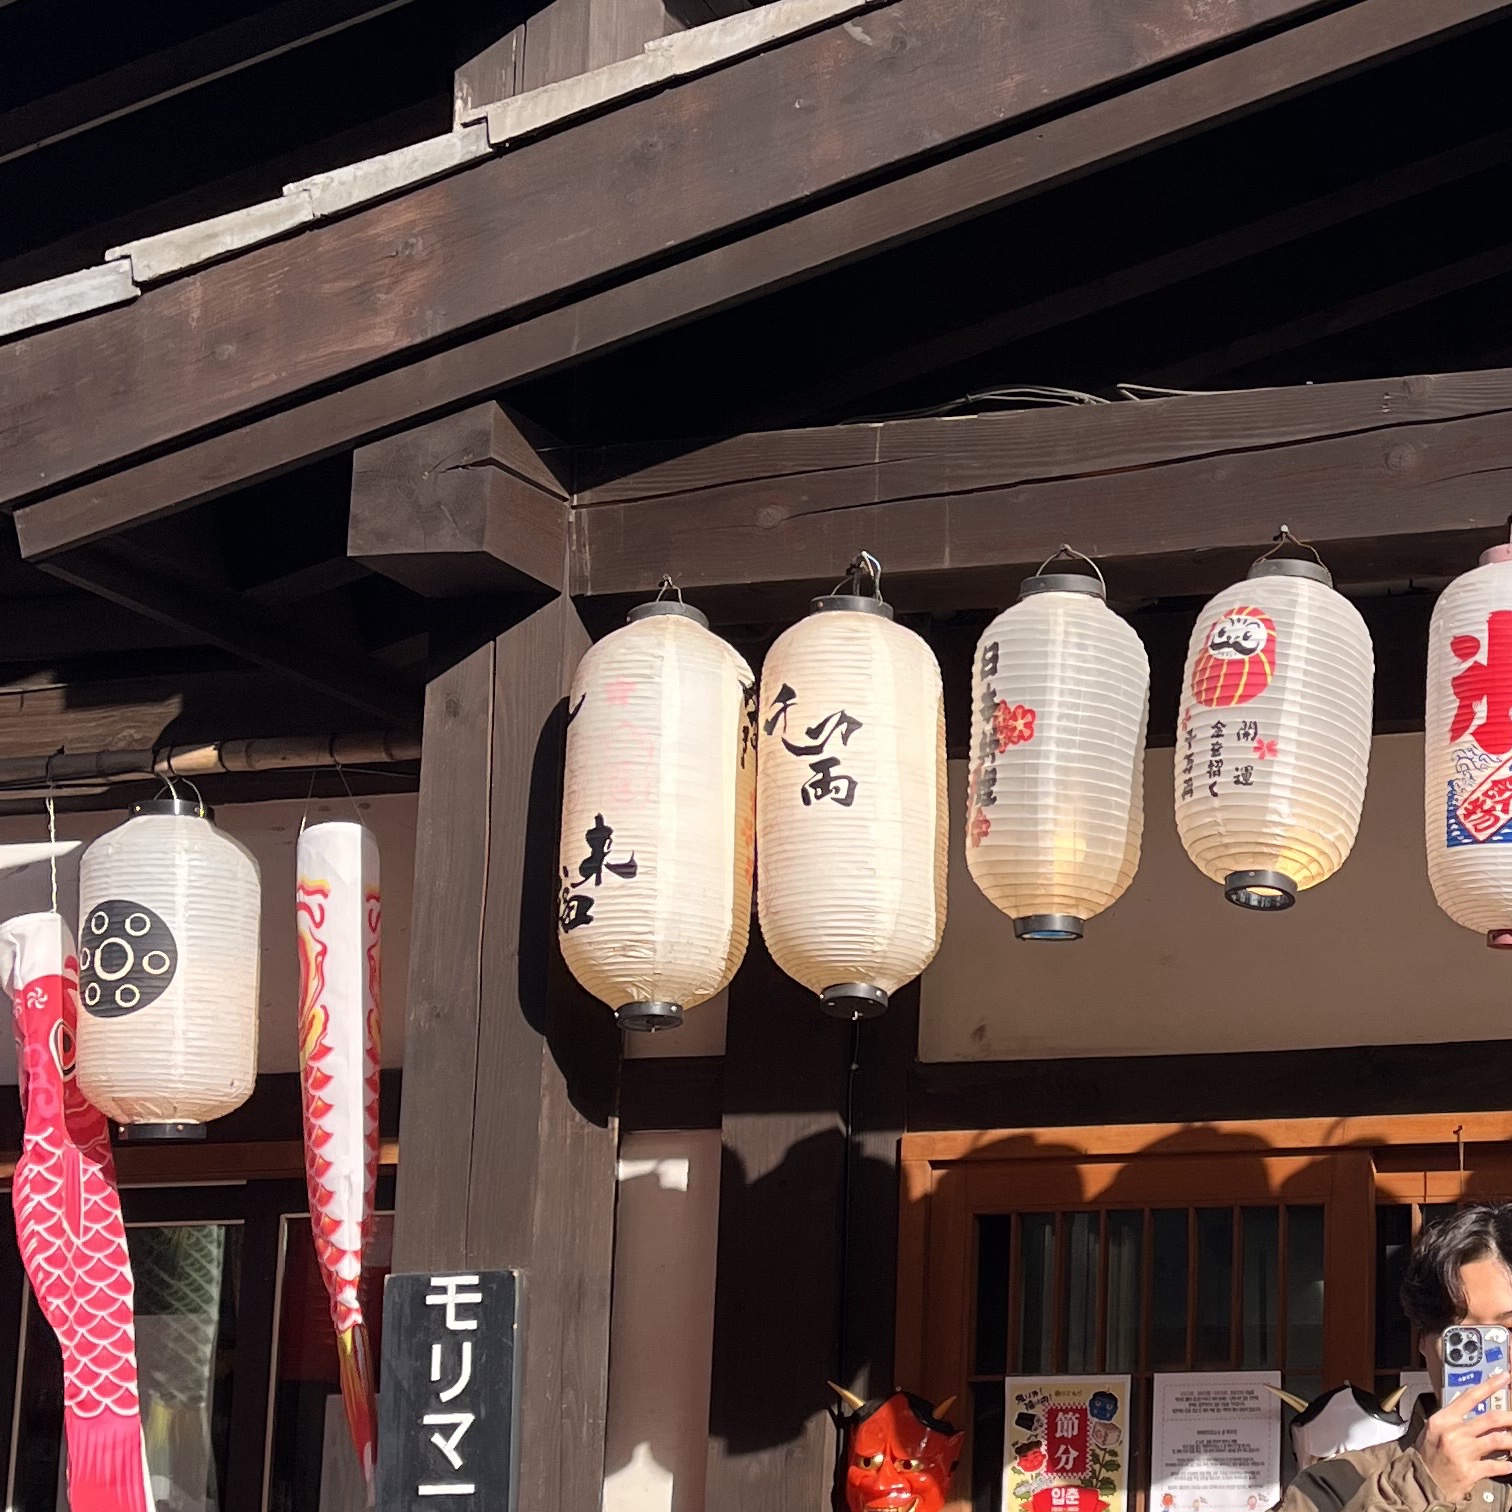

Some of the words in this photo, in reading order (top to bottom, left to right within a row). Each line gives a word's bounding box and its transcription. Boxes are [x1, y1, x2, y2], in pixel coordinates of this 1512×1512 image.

[1233, 720, 1258, 786] 開運
[1055, 1411, 1080, 1471] 節分
[1051, 1487, 1080, 1506] 입춘
